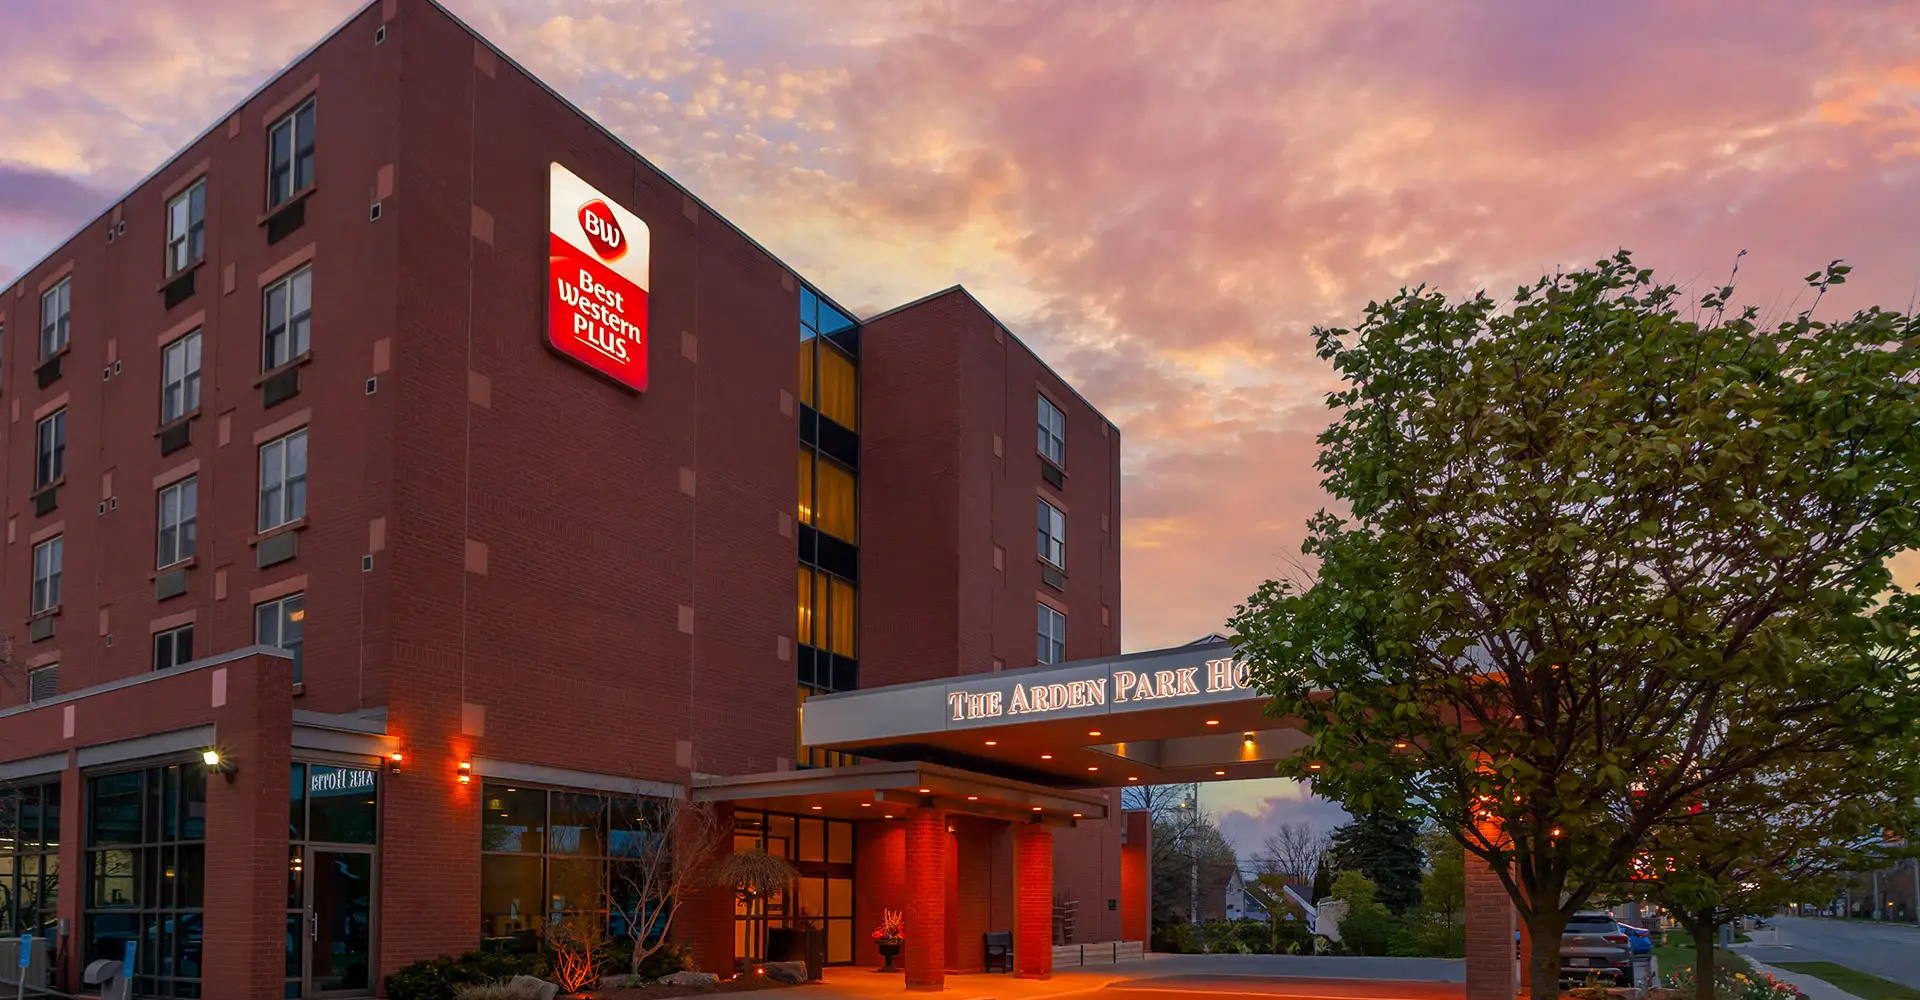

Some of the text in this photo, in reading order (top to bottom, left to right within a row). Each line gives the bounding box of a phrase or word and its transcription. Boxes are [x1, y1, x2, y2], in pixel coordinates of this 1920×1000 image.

[585, 209, 620, 248] BW
[557, 278, 642, 344] Western
[579, 269, 624, 313] Best
[949, 691, 1002, 720] THE
[1007, 679, 1105, 715] ARDEN
[1113, 667, 1199, 702] PARK
